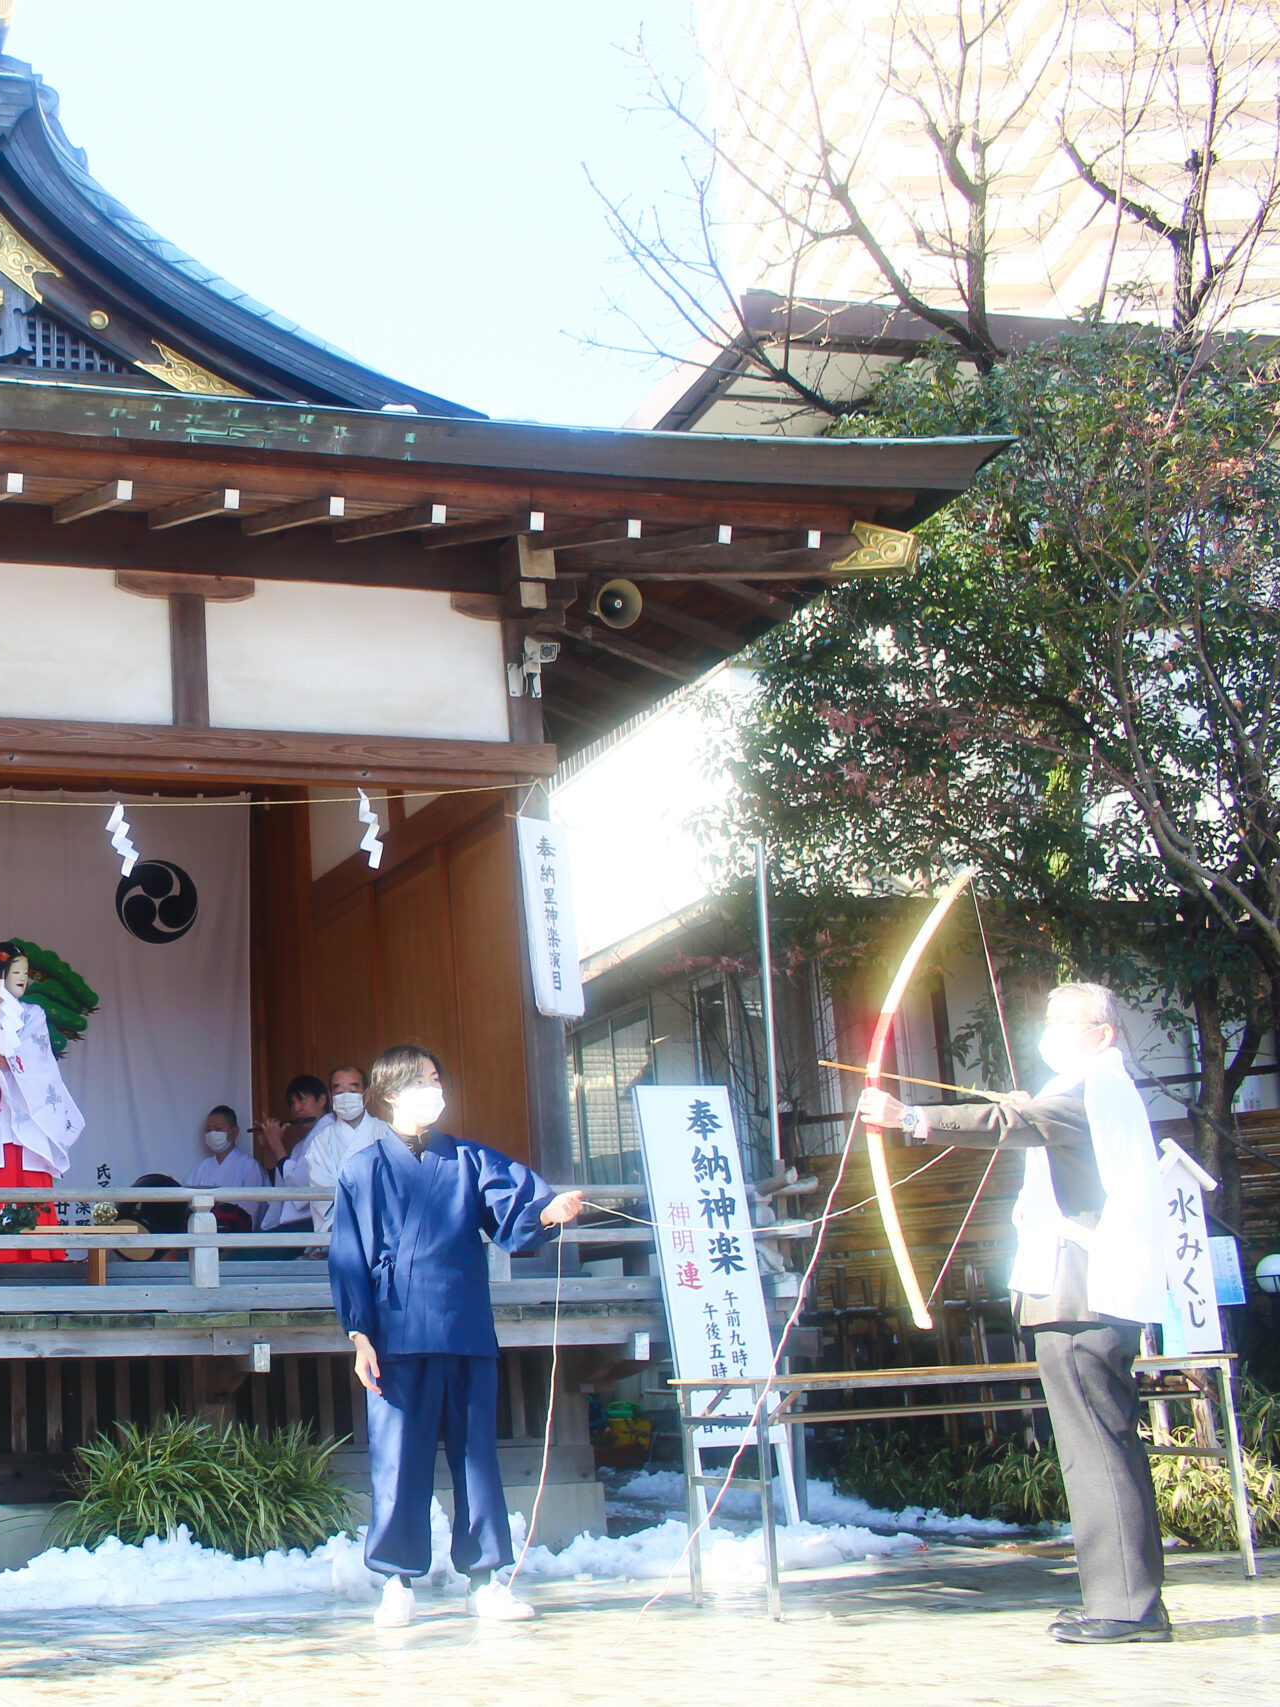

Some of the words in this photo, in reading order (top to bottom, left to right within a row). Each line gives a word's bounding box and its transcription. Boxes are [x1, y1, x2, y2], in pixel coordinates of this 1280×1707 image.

[686, 1099, 747, 1275] 奉納神楽
[1168, 1188, 1206, 1328] 水みくじ
